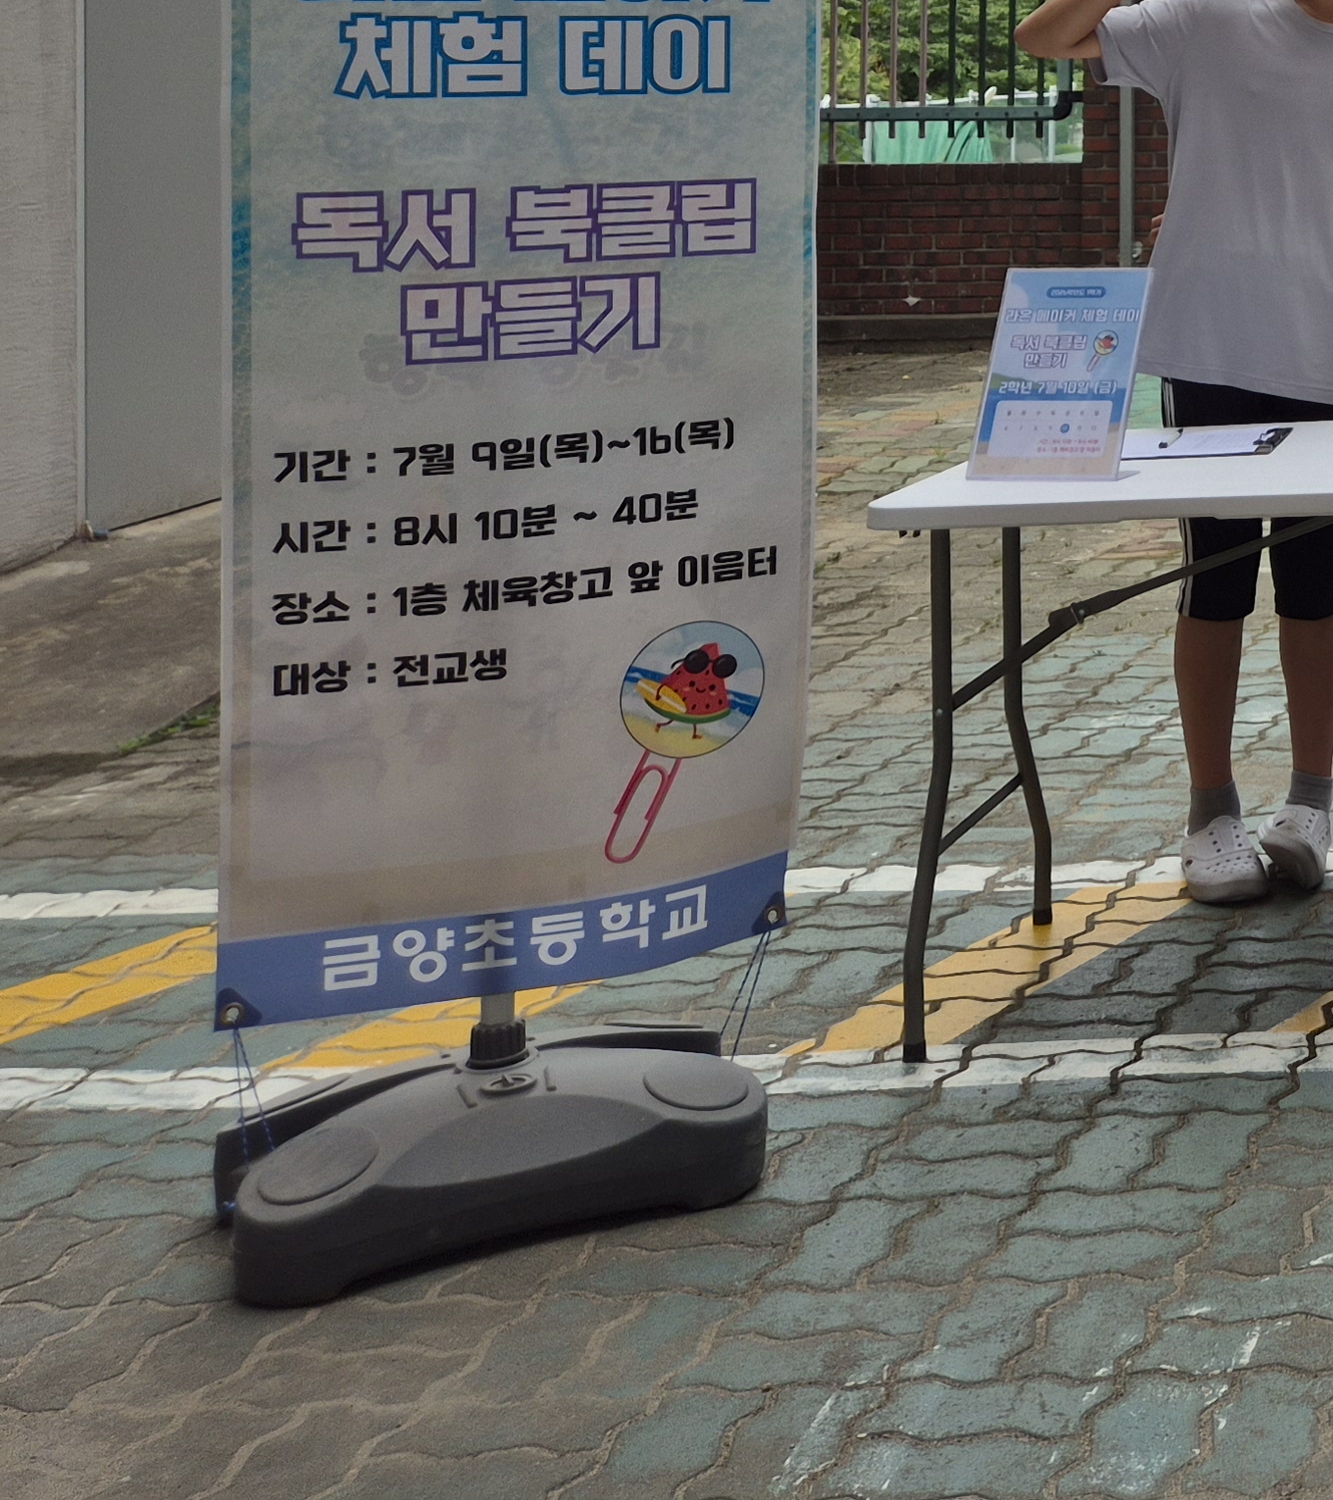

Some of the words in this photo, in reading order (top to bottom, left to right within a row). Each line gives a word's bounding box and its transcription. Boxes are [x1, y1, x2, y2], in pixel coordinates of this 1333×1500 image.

[333, 10, 529, 100] 체험
[558, 15, 732, 97] 데이
[291, 187, 477, 273] 독서
[505, 177, 757, 263] 북클립
[400, 271, 661, 366] 만들기
[1004, 308, 1033, 323] 라온
[1036, 308, 1077, 323] 메이커
[1081, 308, 1108, 323] 체험
[1113, 308, 1140, 323] 데이
[1010, 335, 1040, 351] 독서
[1044, 334, 1088, 350] 북클립
[1024, 353, 1068, 369] 만들기
[273, 448, 351, 484] 기간
[392, 443, 455, 479] 7월
[272, 518, 351, 555] 시간
[392, 511, 458, 547] 8시
[474, 503, 558, 542] 10분
[612, 488, 699, 527] 40분
[271, 590, 351, 626] 장소
[392, 581, 448, 619] 1층
[461, 565, 613, 614] 체육창고
[628, 560, 664, 595] 앞
[678, 546, 779, 589] 이음터
[272, 660, 351, 698] 대상
[392, 648, 508, 689] 전교생
[323, 884, 709, 993] 금양초등학교
